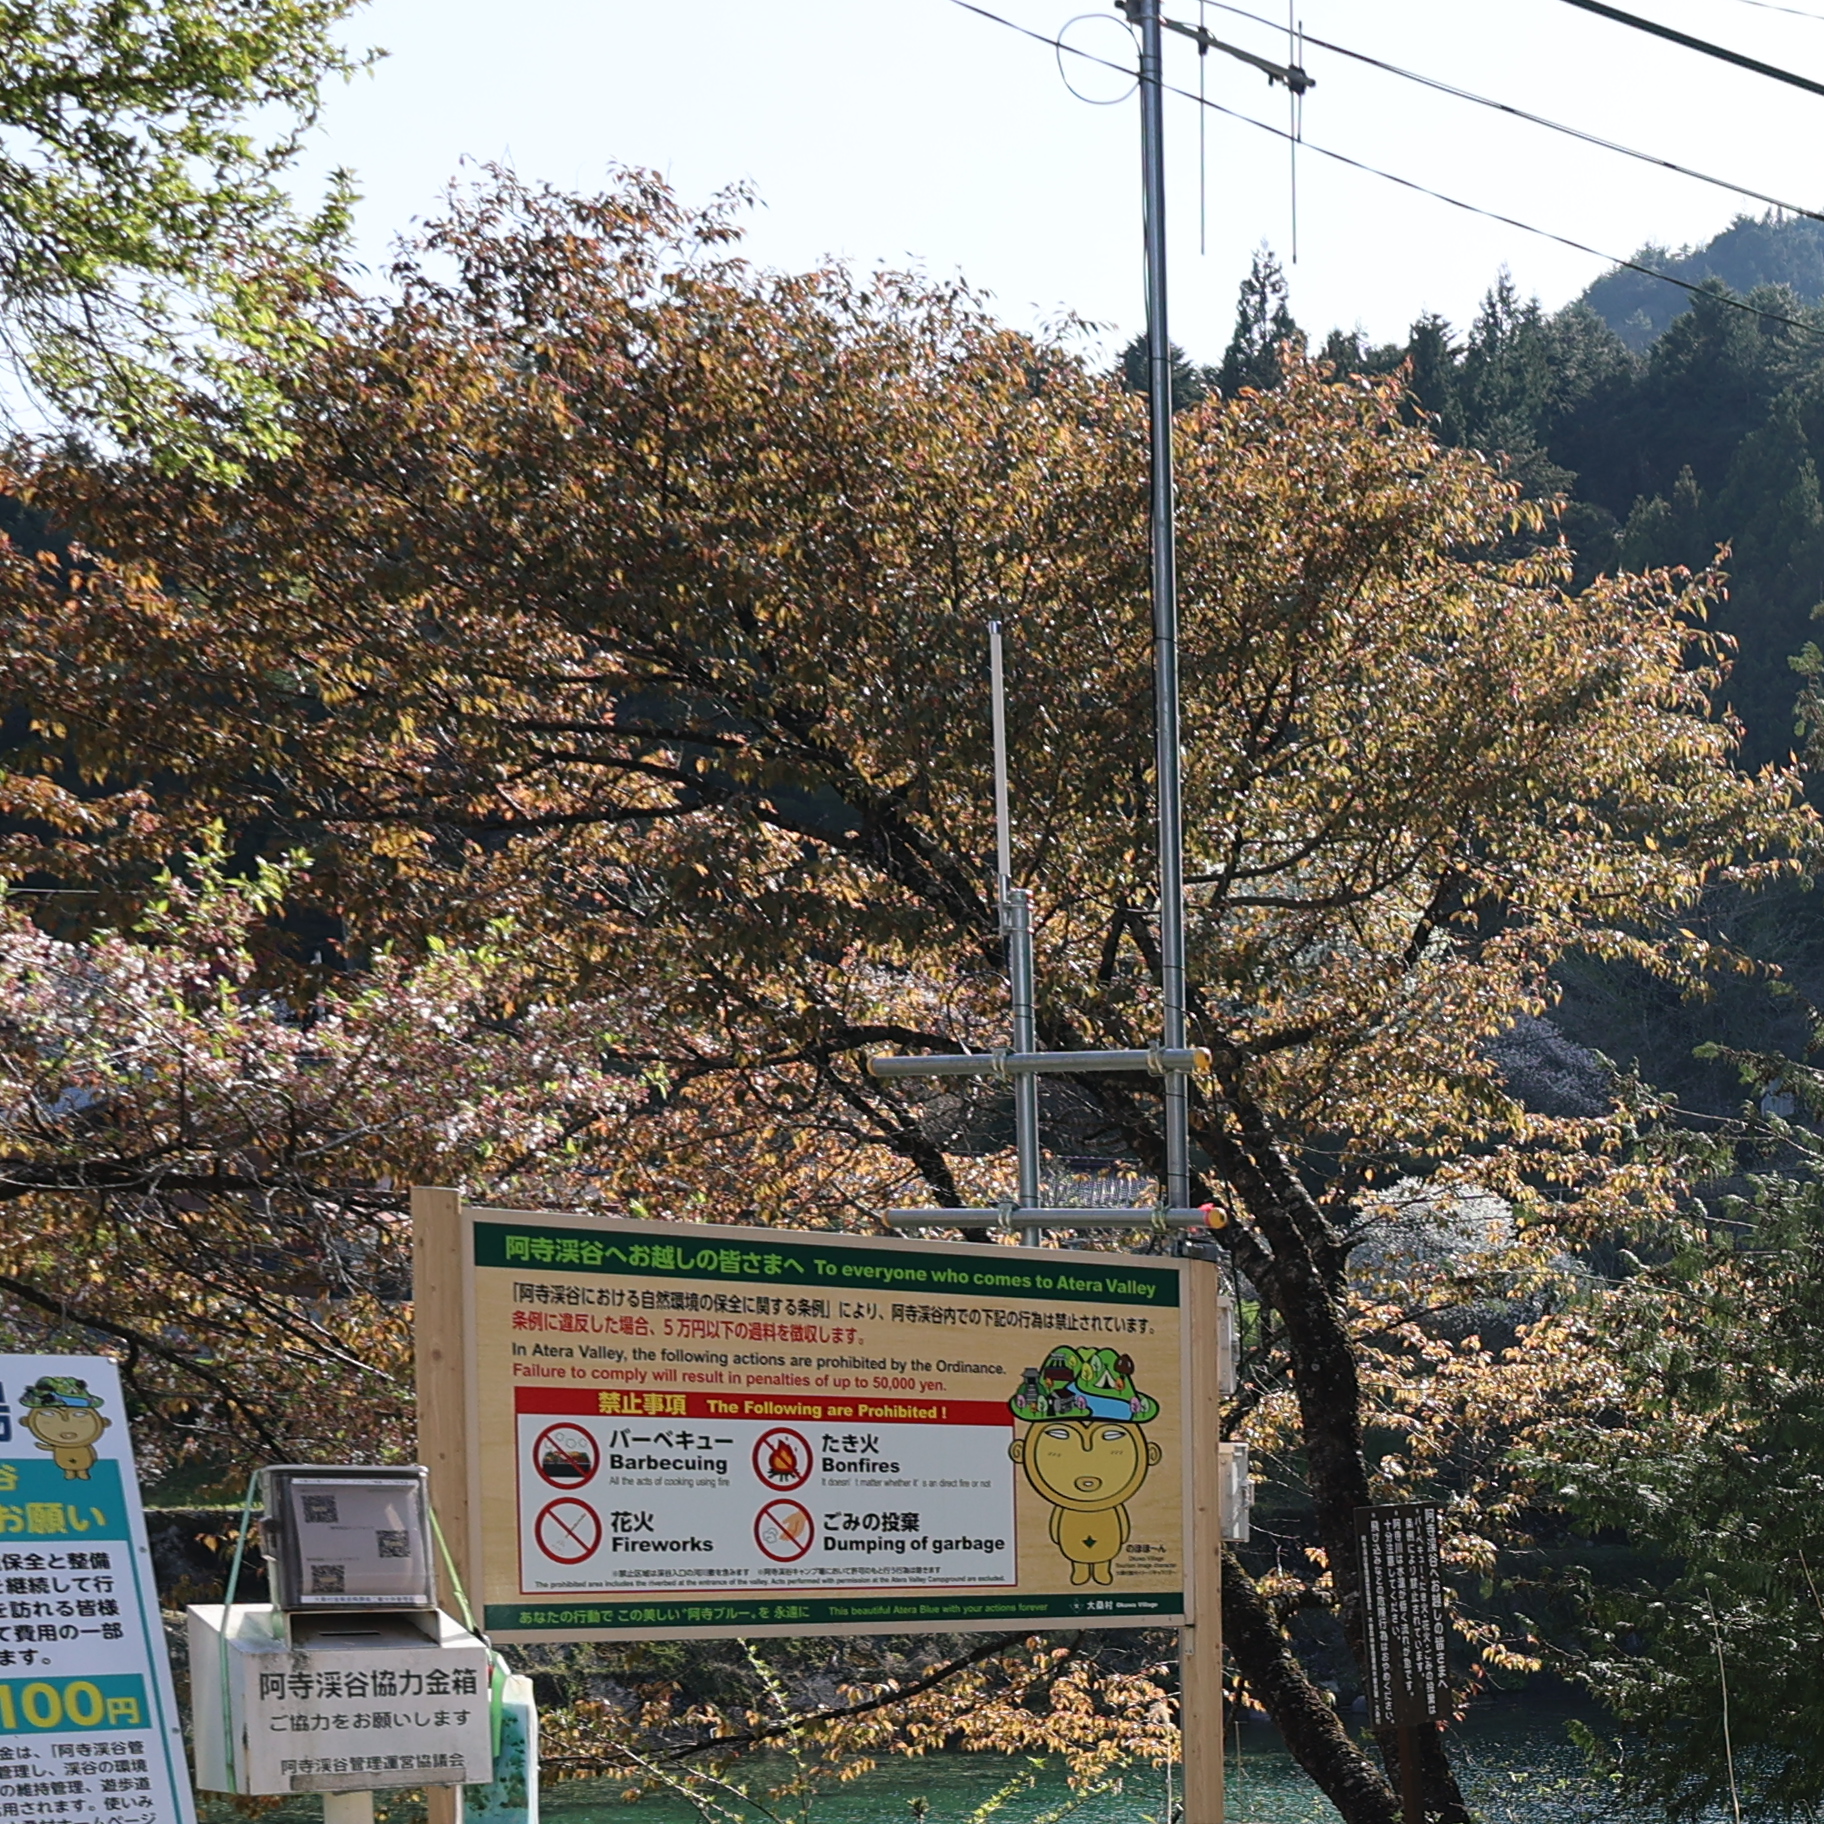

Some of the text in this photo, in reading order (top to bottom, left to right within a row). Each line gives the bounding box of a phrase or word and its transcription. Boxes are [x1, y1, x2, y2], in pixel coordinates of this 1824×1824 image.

[505, 1235, 805, 1274] 阿寺渓谷へお越しの皆さまへ
[813, 1259, 1156, 1298] To everyone who comes to Atera Valley
[512, 1343, 1007, 1375] In Atera Valley, the following actions are prohibited by the Ordinance.
[512, 1363, 947, 1393] Failure to comply will result in penalties of up to 50,000 yen.
[598, 1392, 686, 1416] 禁止事項
[707, 1400, 738, 1414] The
[744, 1401, 821, 1418] Following
[826, 1405, 852, 1417] are
[858, 1404, 936, 1419] Prohibited
[610, 1430, 734, 1450] バーベキュー
[822, 1433, 880, 1454] たき火
[610, 1454, 728, 1475] Barbecuing
[822, 1457, 900, 1473] Bonfires
[609, 1476, 730, 1488] All the acts of cooking using fire
[860, 1479, 882, 1487] matter
[884, 1479, 911, 1488] whether
[939, 1479, 957, 1488] direct
[980, 1480, 991, 1488] not
[611, 1511, 654, 1532] 花火
[823, 1511, 920, 1532] ごみの投棄
[612, 1537, 714, 1552] Fireworks
[823, 1536, 1005, 1554] Dumping of garbage
[0, 1552, 111, 1571] 保全と整備
[519, 1610, 614, 1624] あなたの行動で
[828, 1602, 1048, 1616] This beautiful Atera Blue with your actions forever
[259, 1668, 477, 1700] 阿寺渓谷協力金箱
[269, 1710, 471, 1732] ご協力をお願いします
[281, 1754, 465, 1776] 阿寺渓谷管理運営協議会
[0, 1795, 153, 1817] 用されます。使いみ
